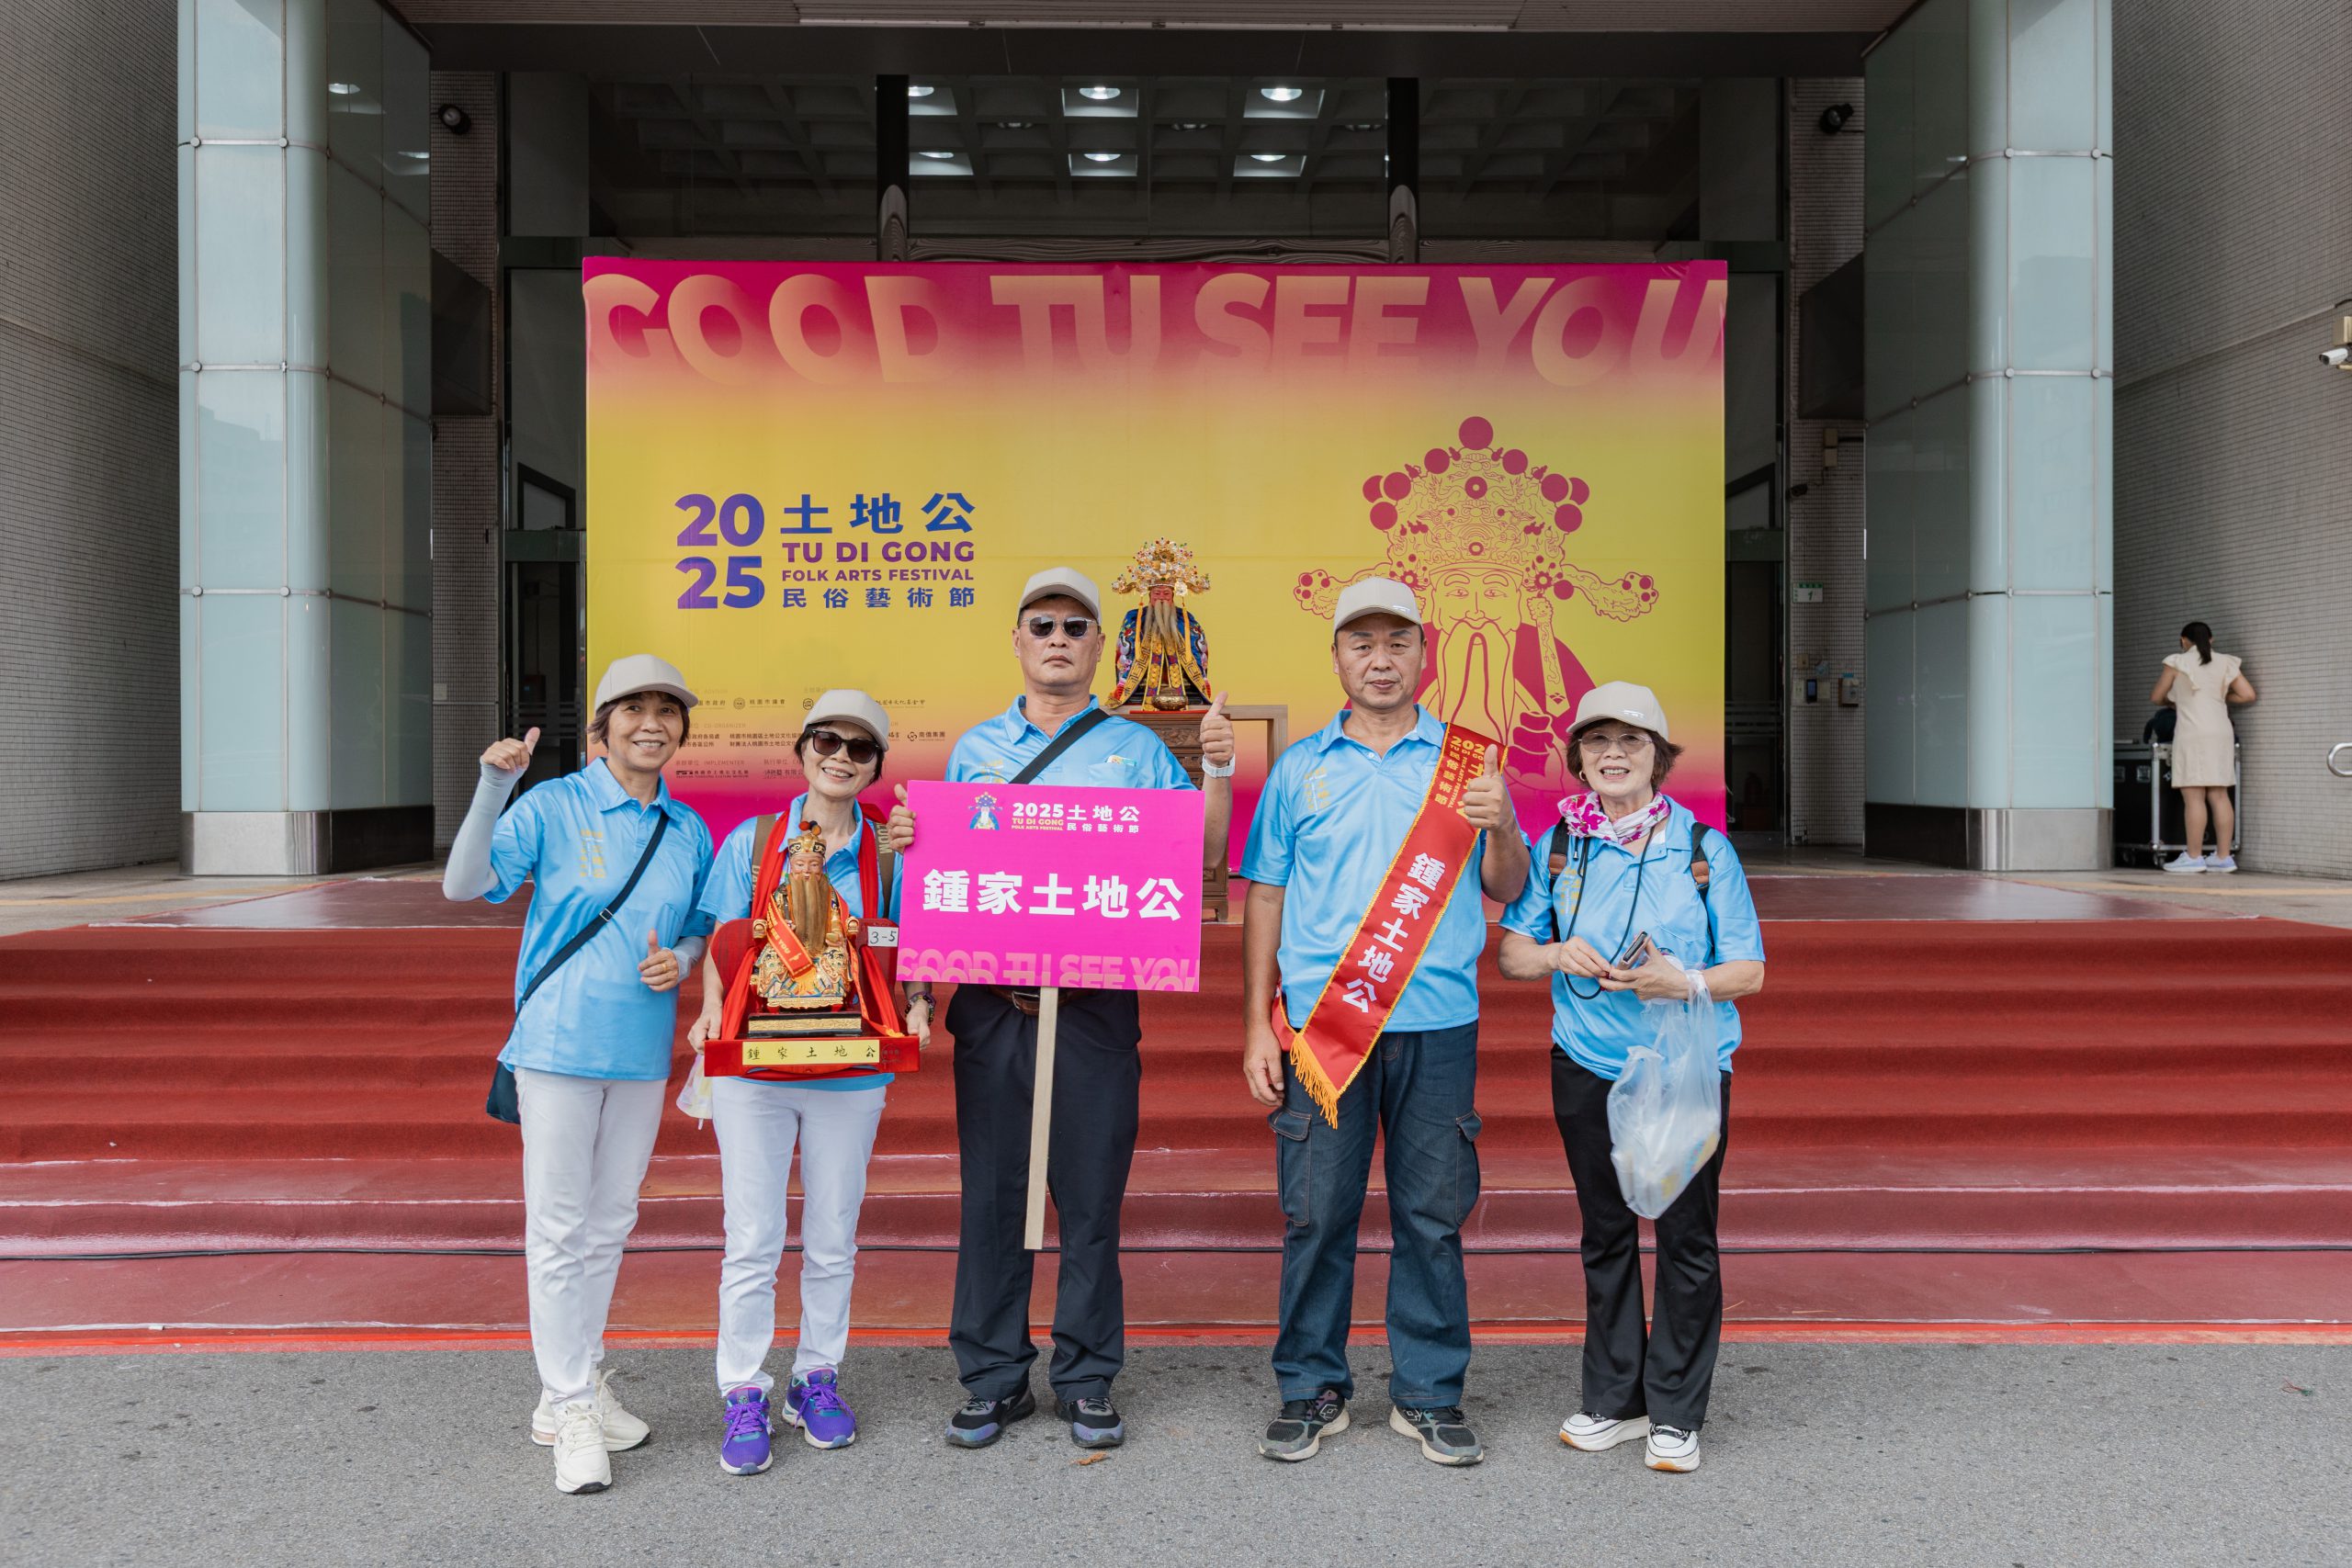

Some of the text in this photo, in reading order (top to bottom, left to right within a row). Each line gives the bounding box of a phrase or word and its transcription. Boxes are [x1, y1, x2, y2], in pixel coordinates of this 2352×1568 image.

[582, 272, 1727, 386] GOOD TU SEE YOU
[674, 493, 765, 547] 20
[780, 492, 976, 535] 土地公
[782, 541, 975, 563] TU DI GONG
[674, 556, 765, 609] 25
[782, 569, 974, 581] FOLK ARTS FESTIVAL
[782, 587, 975, 609] 民俗藝術節
[1451, 736, 1486, 756] 202
[1012, 802, 1065, 818] 2025
[1067, 804, 1140, 822] 土地公
[1025, 818, 1036, 826] DI
[1038, 818, 1064, 826] GONG
[1066, 822, 1139, 834] 民俗藝術節
[922, 868, 1184, 921] 鍾家土地公
[869, 931, 898, 945] 3-5
[1341, 852, 1446, 1013] 鍾家土地公
[778, 939, 791, 954] YOU
[748, 1045, 876, 1060] 鍾家土地公
